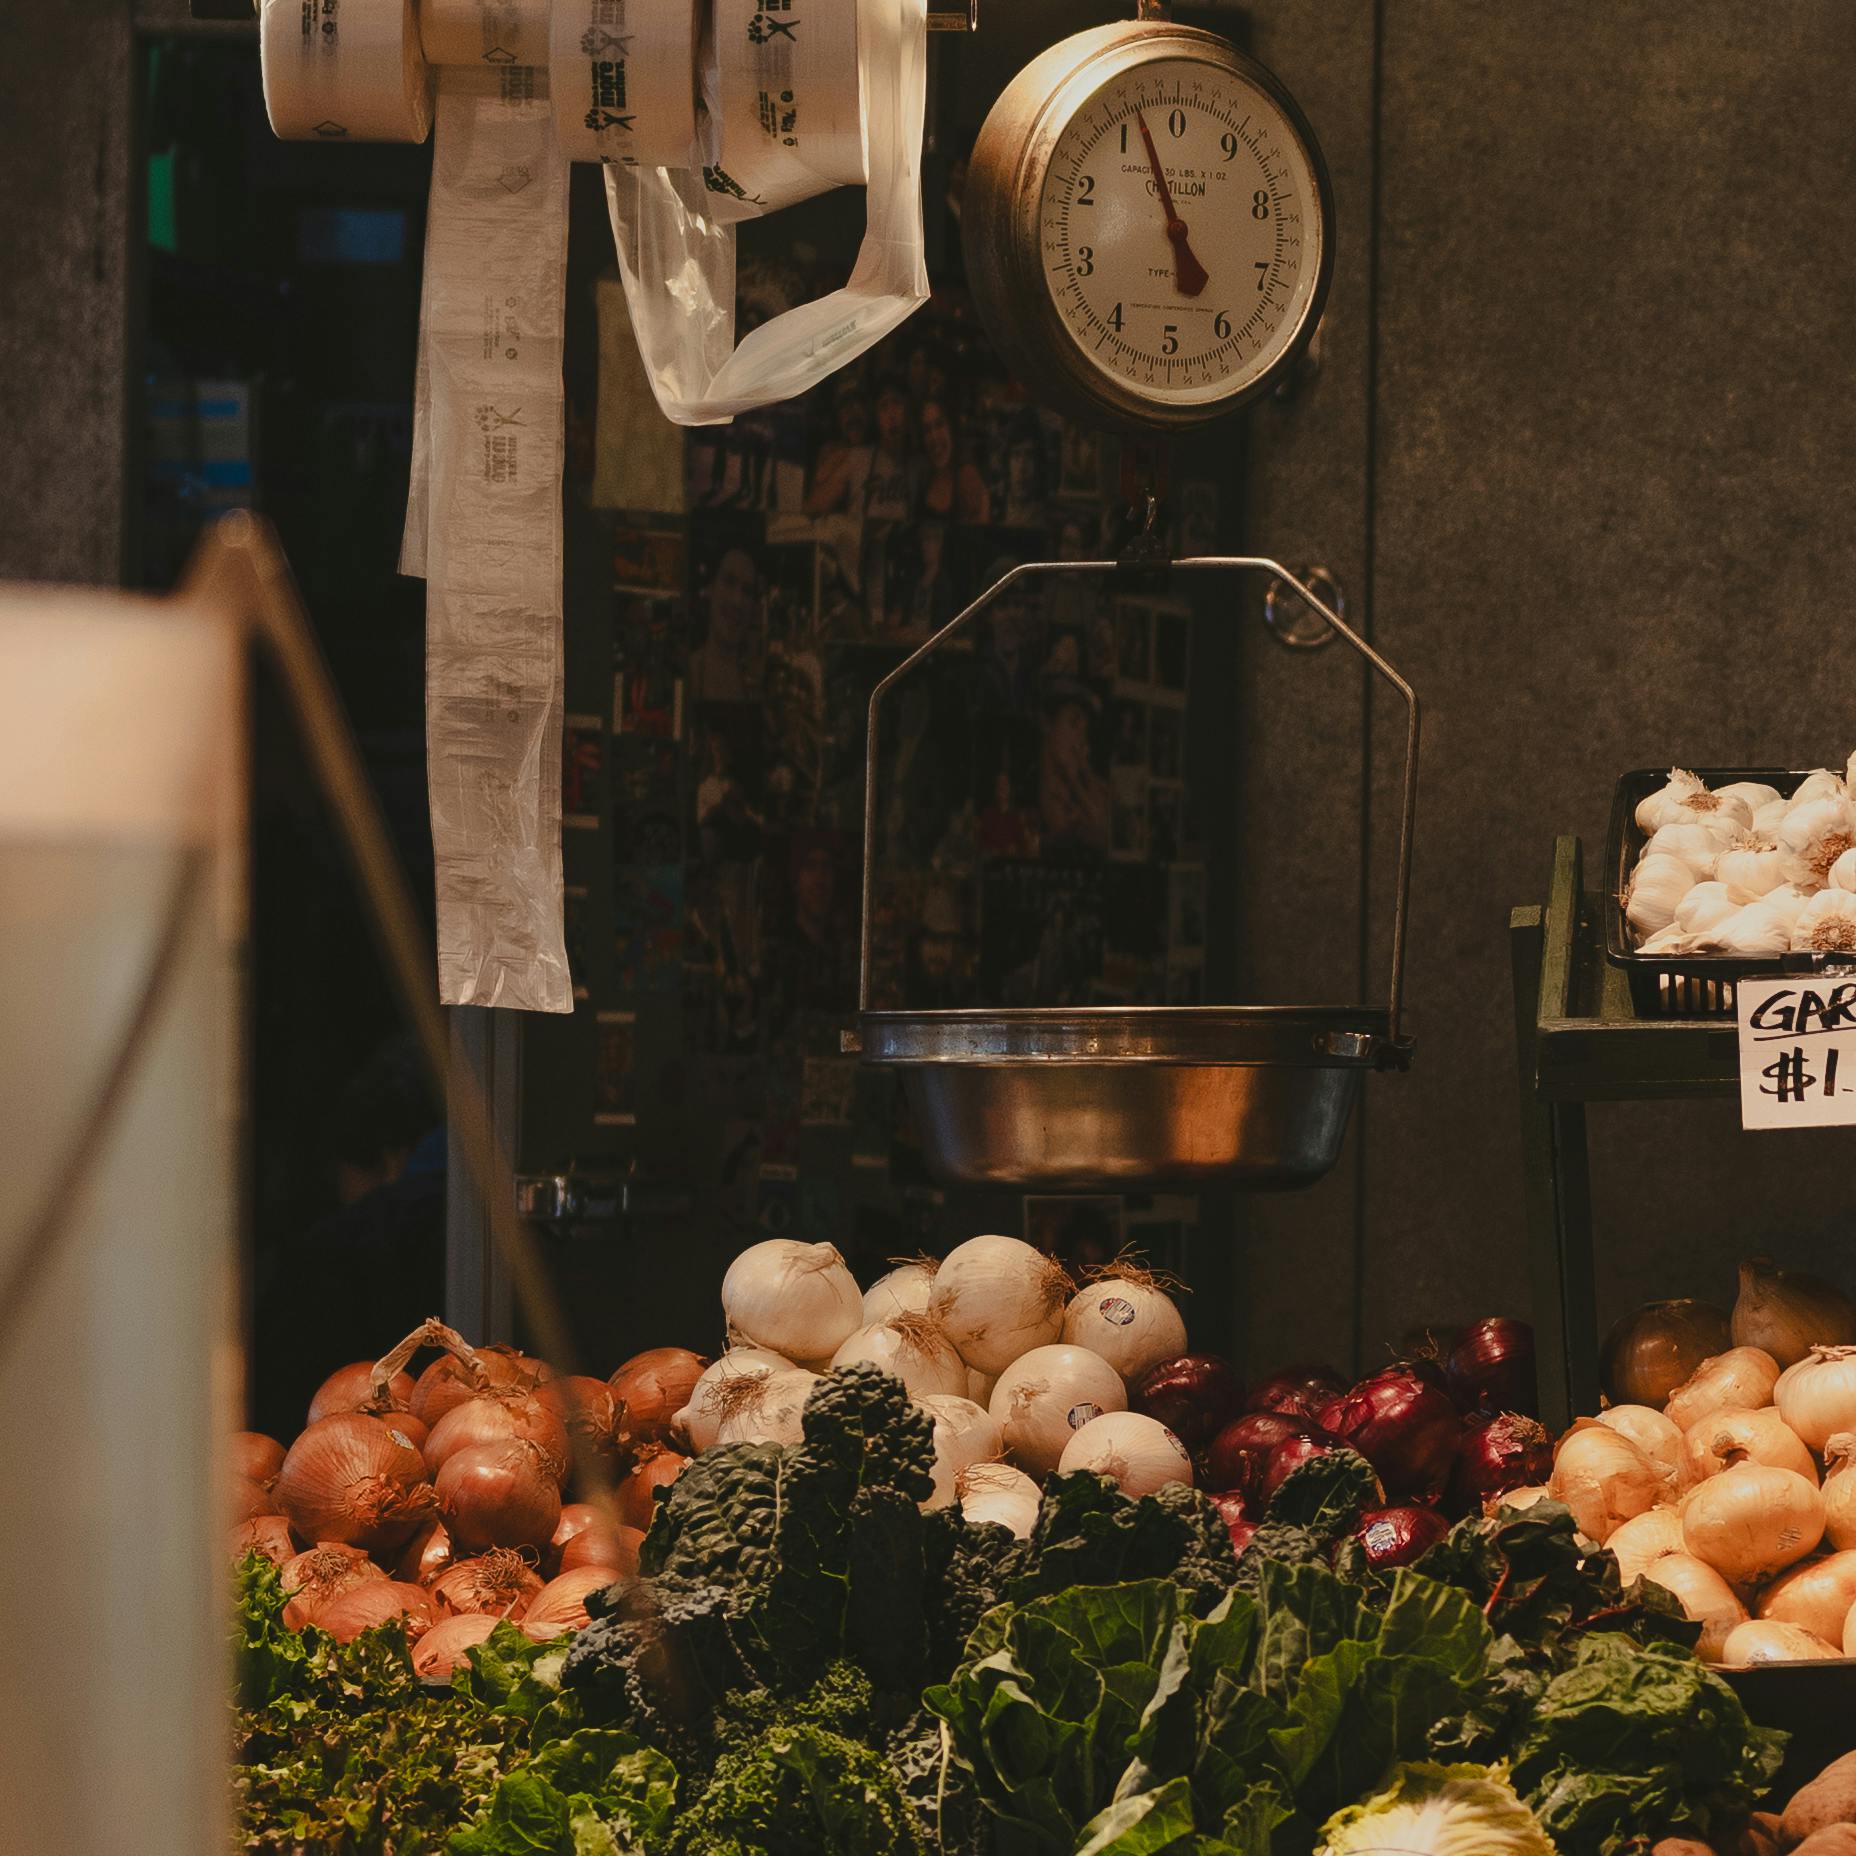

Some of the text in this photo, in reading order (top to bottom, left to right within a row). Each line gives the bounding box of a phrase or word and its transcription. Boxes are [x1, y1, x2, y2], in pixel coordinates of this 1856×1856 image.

[1169, 109, 1186, 138] 0
[1121, 123, 1128, 154] 1
[1221, 133, 1238, 162] 9
[1121, 164, 1155, 175] CAPACI
[1164, 167, 1176, 177] 30
[1077, 175, 1095, 206] 2
[1146, 179, 1206, 197] CHTILLON
[1252, 190, 1269, 220] 8
[1077, 246, 1094, 276] 3
[1254, 262, 1270, 291] 7
[1107, 302, 1125, 332] 4
[1214, 310, 1231, 339] 6
[1162, 325, 1178, 354] 5
